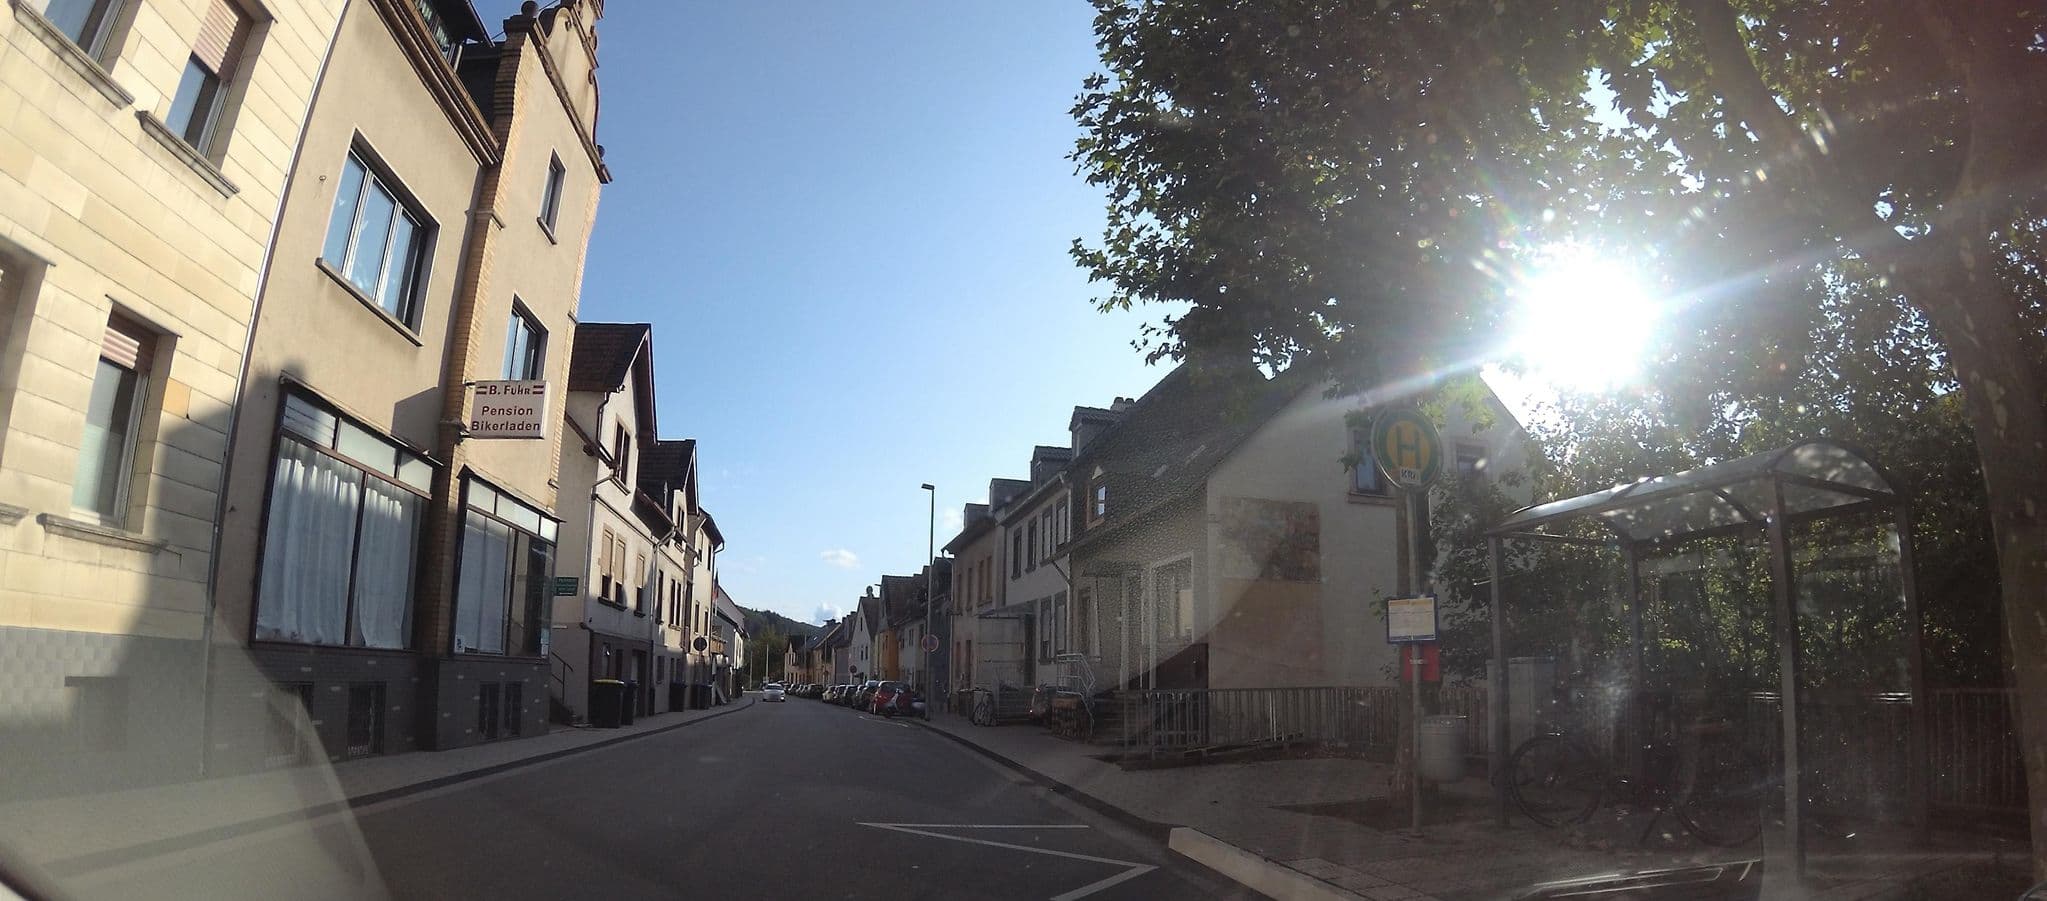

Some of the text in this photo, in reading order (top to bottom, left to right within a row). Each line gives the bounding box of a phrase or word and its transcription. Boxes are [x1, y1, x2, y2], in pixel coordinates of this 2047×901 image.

[489, 385, 501, 395] B.
[481, 405, 534, 416] Pension
[471, 420, 541, 431] Bikerladen
[1396, 425, 1422, 469] H
